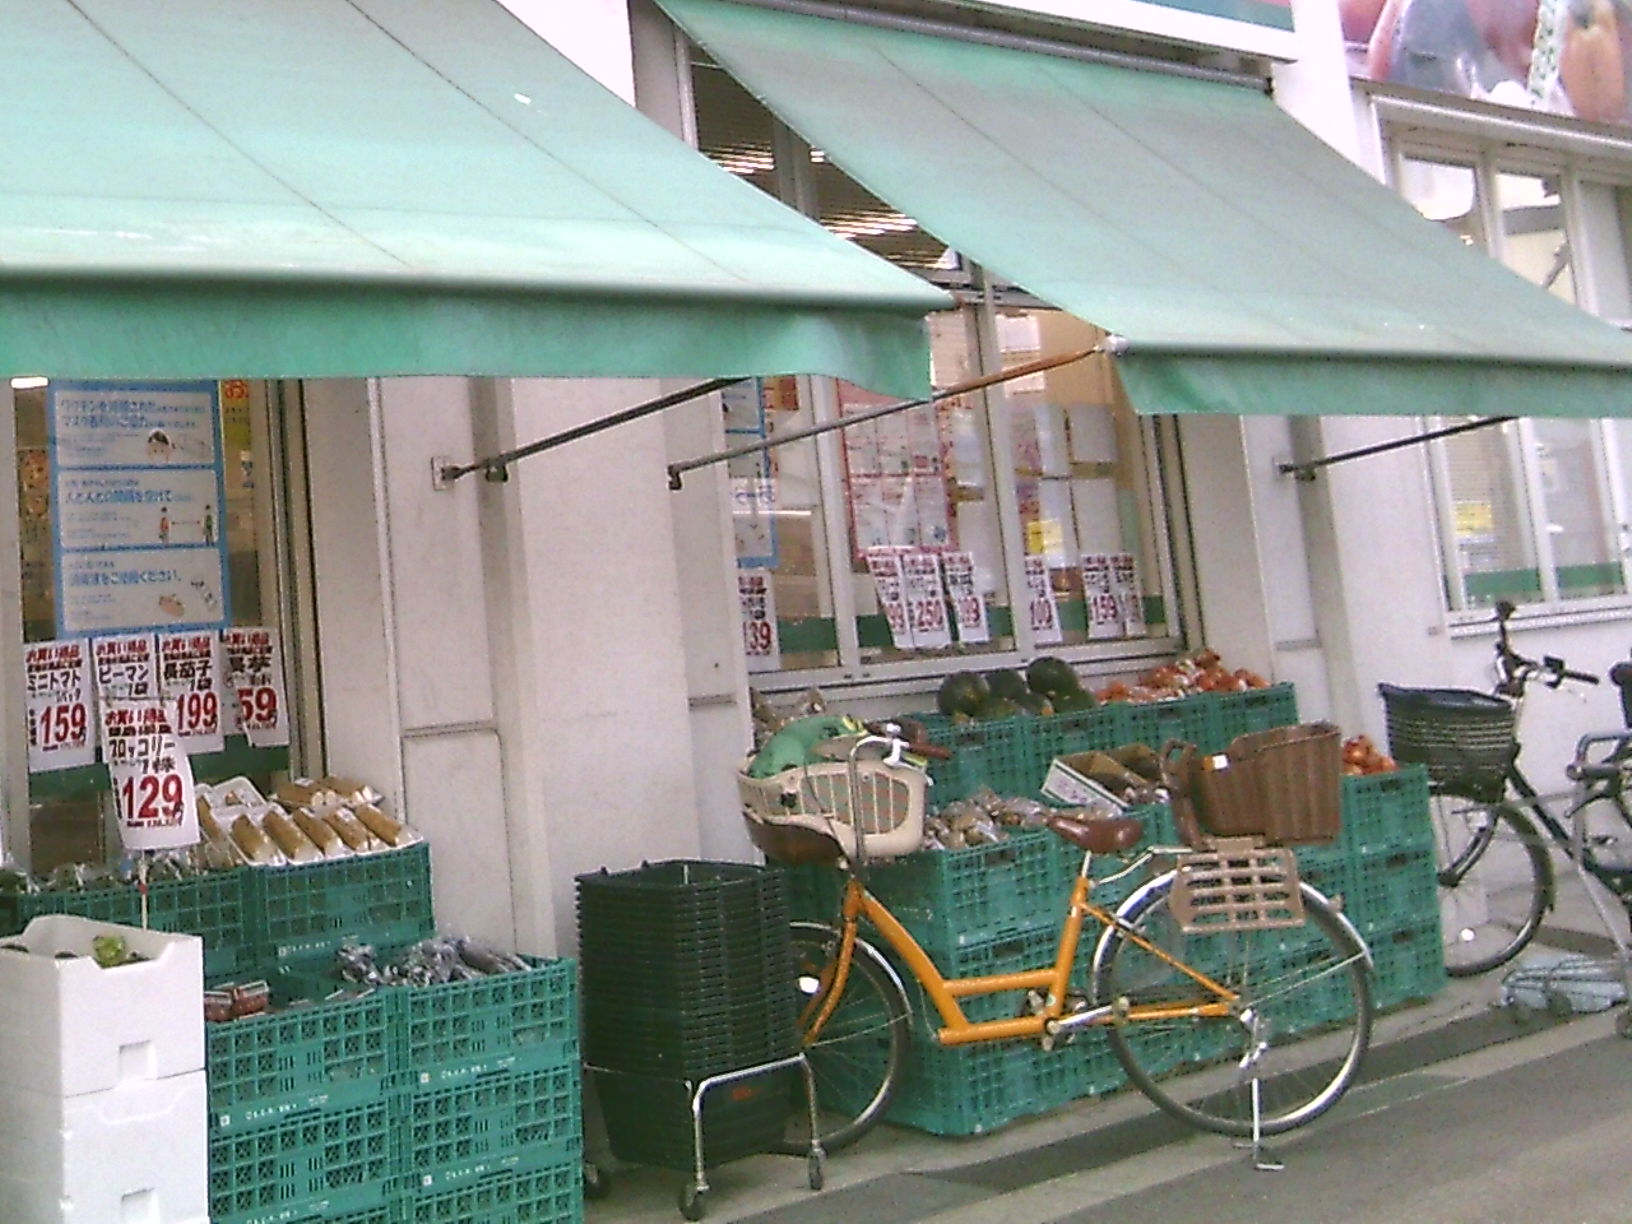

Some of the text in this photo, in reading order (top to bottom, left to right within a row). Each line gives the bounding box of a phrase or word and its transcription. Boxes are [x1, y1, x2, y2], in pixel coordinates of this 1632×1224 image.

[27, 669, 81, 692] ミニトマト
[122, 774, 183, 820] 129
